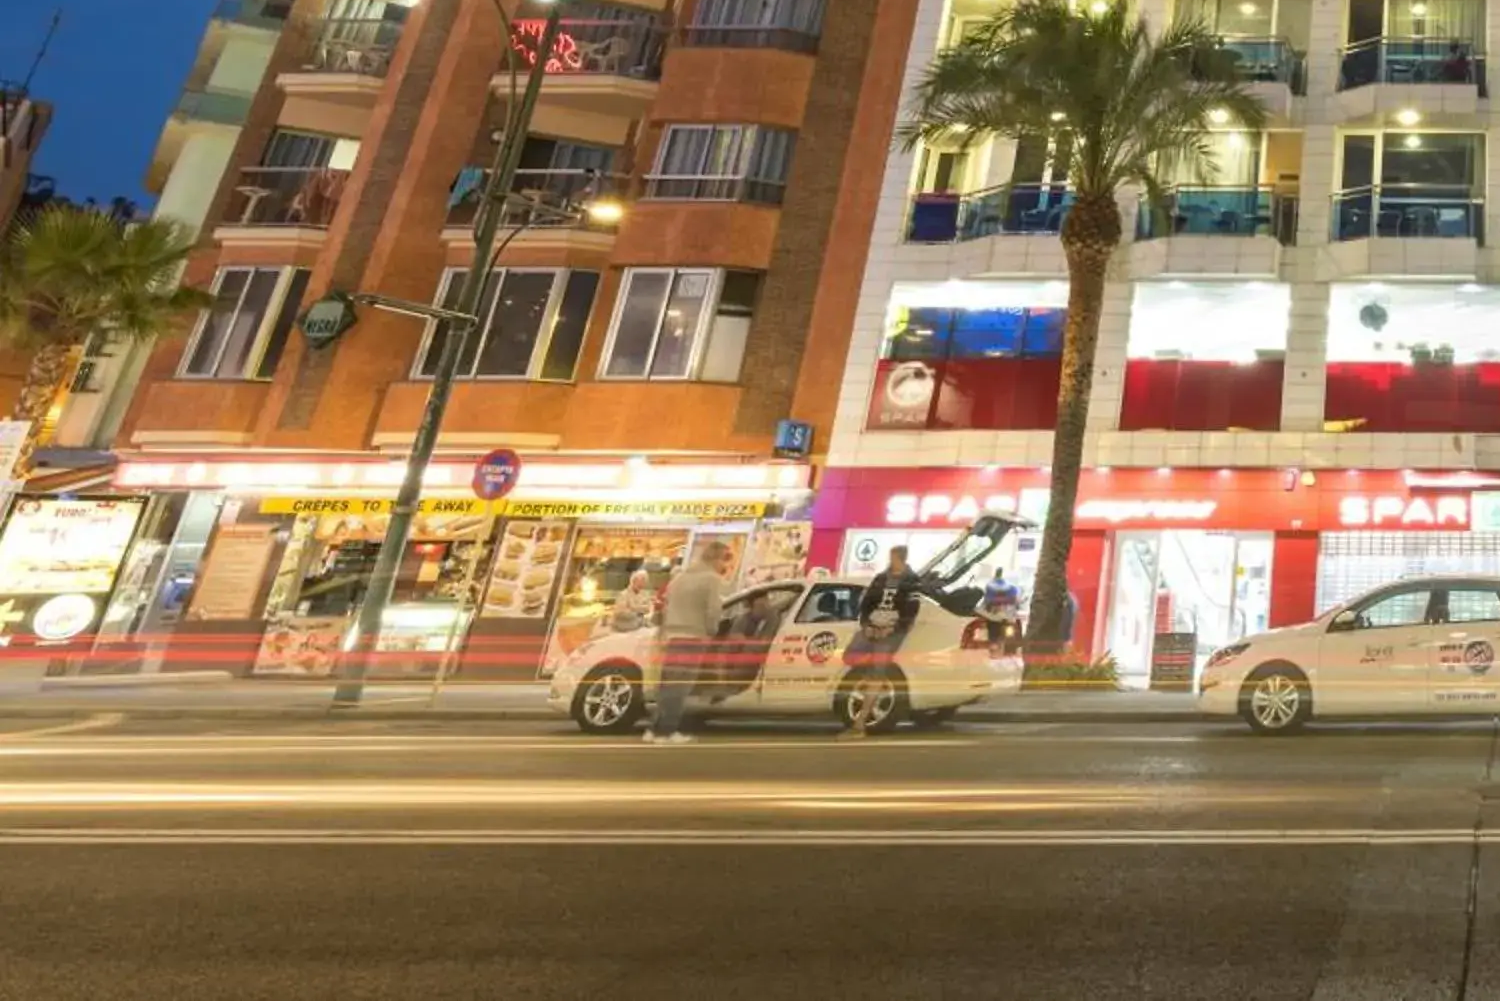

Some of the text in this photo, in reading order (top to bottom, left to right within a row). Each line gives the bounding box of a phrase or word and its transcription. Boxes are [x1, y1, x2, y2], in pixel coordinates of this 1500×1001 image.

[362, 500, 381, 512] TO
[389, 500, 425, 512] TE
[431, 500, 474, 512] AWAY
[513, 504, 577, 515] PORTION
[581, 504, 600, 514] OF
[671, 504, 714, 515] MADE
[1339, 497, 1468, 525] SPAR
